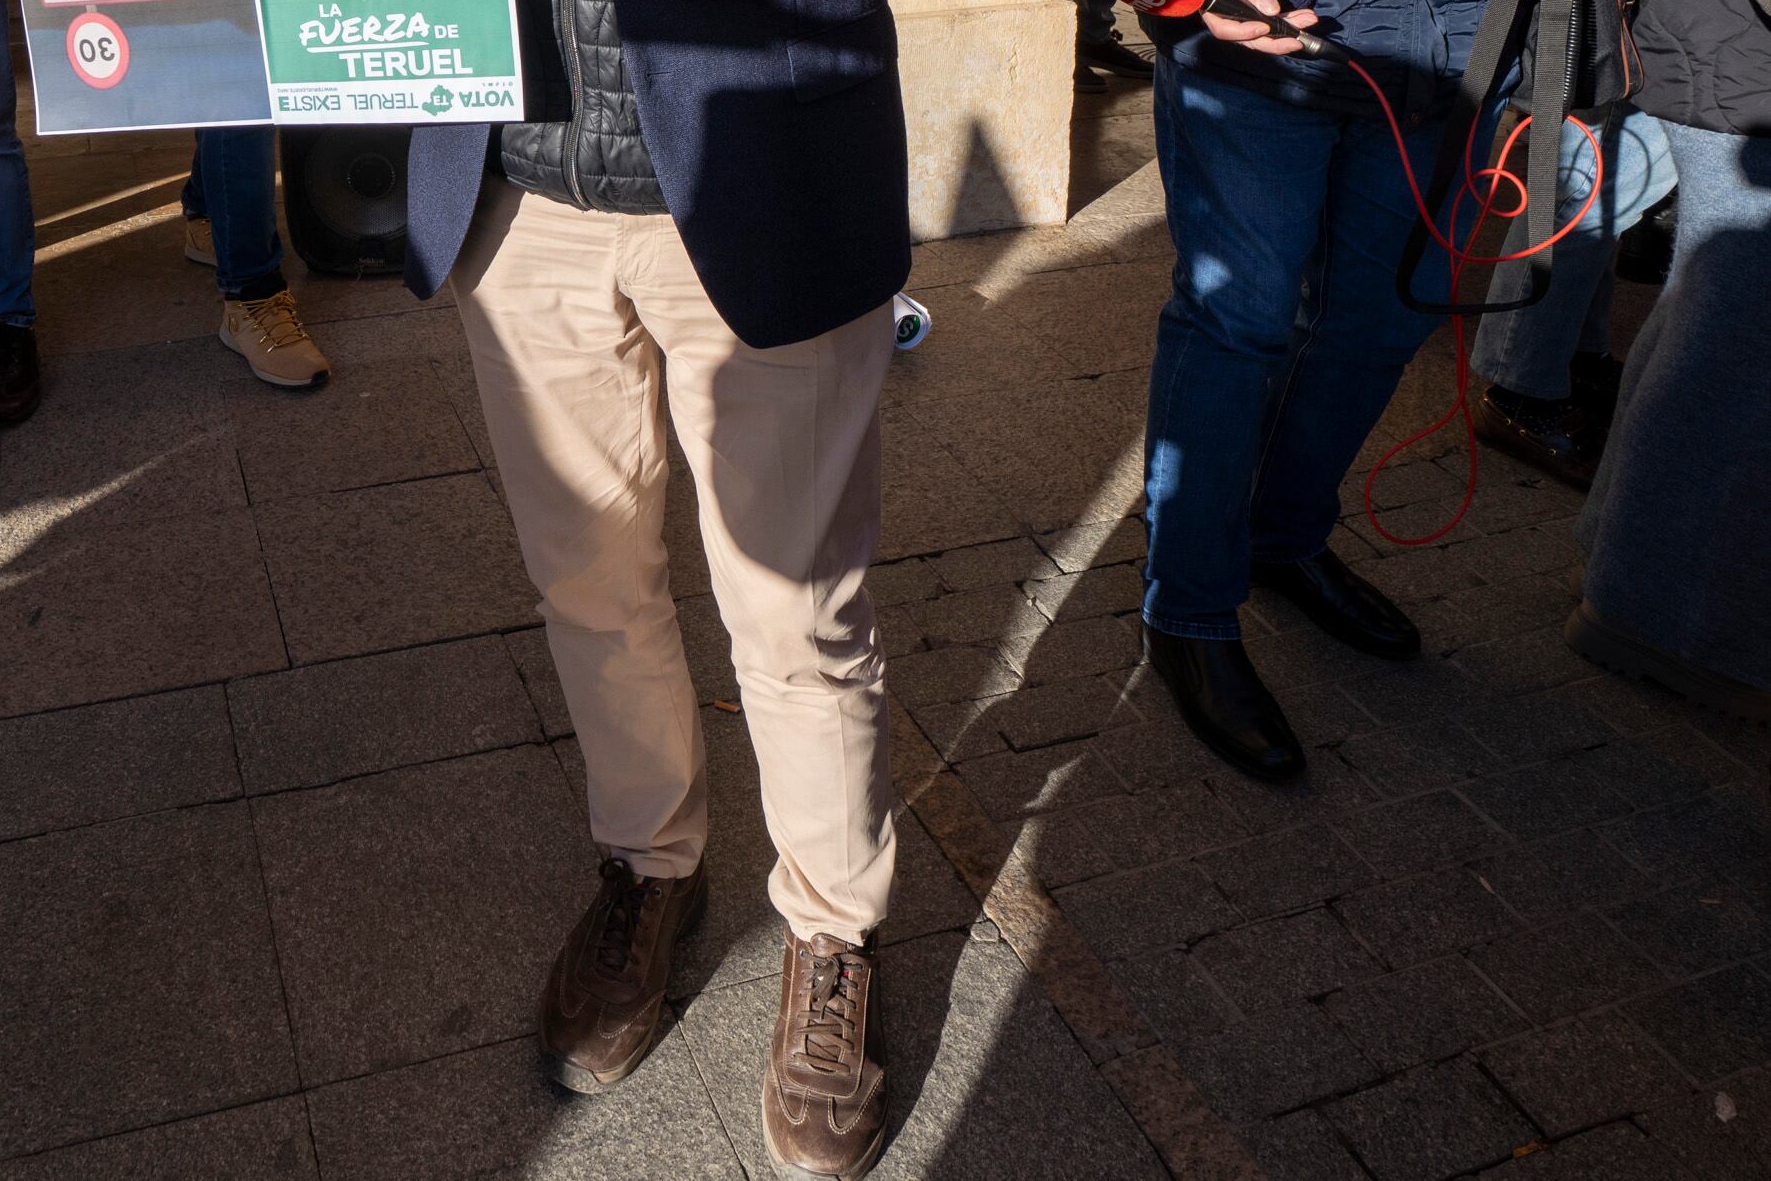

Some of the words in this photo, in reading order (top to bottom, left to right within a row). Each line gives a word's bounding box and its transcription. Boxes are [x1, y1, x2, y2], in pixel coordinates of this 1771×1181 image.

[319, 3, 342, 19] LA
[299, 12, 430, 48] FUERZA
[435, 24, 459, 39] DE
[78, 36, 116, 64] 30
[339, 47, 473, 79] TERUEL
[278, 94, 341, 112] EXISTE
[348, 91, 418, 111] TERUEL
[459, 90, 515, 108] VOTA
